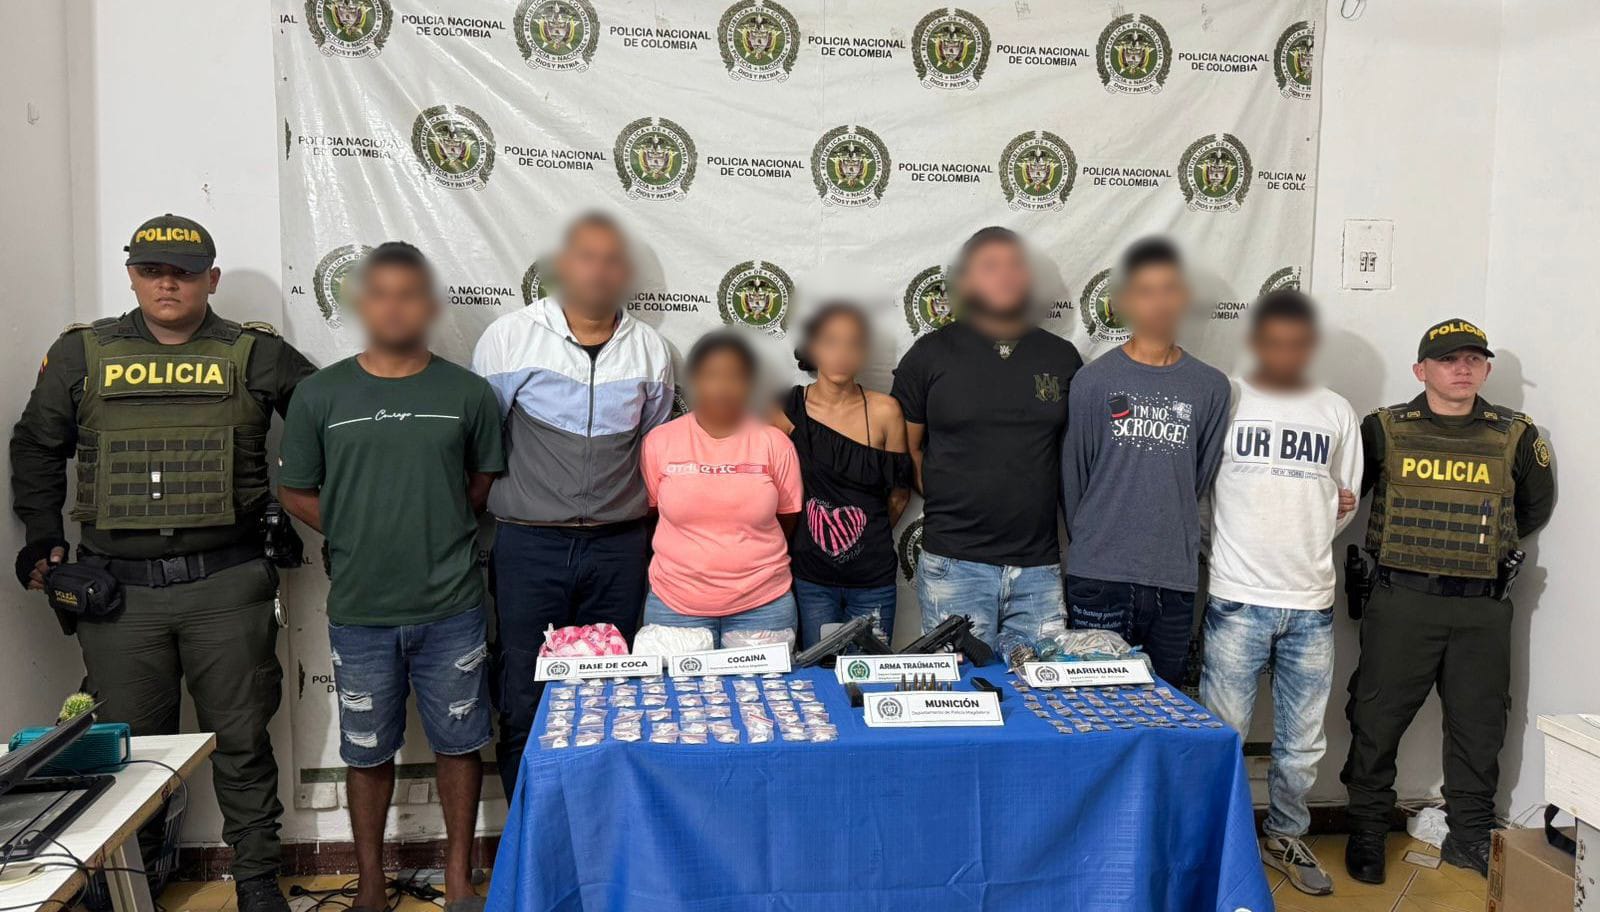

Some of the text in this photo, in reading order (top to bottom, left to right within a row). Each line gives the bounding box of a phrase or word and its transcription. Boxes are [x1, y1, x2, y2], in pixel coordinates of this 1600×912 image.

[402, 15, 505, 30] POLICIA NACIONAL
[416, 26, 491, 38] DE COLOMBIA
[610, 26, 711, 40] POLICIA NACIONAL
[624, 38, 697, 50] DE COLOMBIA
[808, 36, 906, 49] POLICIA NACIONAL
[821, 47, 892, 58] DE COLOMBIA
[996, 45, 1090, 57] POLICIA NACIONAL
[1009, 55, 1077, 66] DE COLOMBIA
[1178, 53, 1270, 63] POLICIA NACIONAL
[1191, 62, 1258, 72] DE COLOMBIA
[504, 146, 607, 160] POLICIA NACIONAL
[519, 157, 594, 170] DE COLOMBIA
[707, 156, 804, 169] POLICIA NACIONAL
[899, 163, 993, 173] POLICIA NACIONAL
[720, 167, 792, 178] DE COLOMBIA
[911, 173, 980, 183] DE COLOMBIA
[1083, 167, 1172, 178] POLICIA NACIONAL
[1258, 171, 1293, 181] POLICIA
[1094, 177, 1159, 187] DE COLOMBIA
[1267, 181, 1280, 190] DE
[136, 229, 201, 243] POLICIA
[458, 286, 515, 296] NACIONAL
[448, 296, 501, 305] OLOMBIA
[658, 293, 711, 303] NACIONAL
[627, 302, 698, 312] DE COLOMBIA
[104, 363, 224, 386] POLICIA
[1134, 405, 1149, 418] I'M
[1152, 408, 1168, 420] NO
[1113, 418, 1187, 444] SCROOGE!
[1402, 458, 1490, 484] POLICIA
[728, 654, 766, 663] COCAINA
[1066, 667, 1129, 675] MARIHUANA
[925, 698, 979, 708] MUNICIÓN
